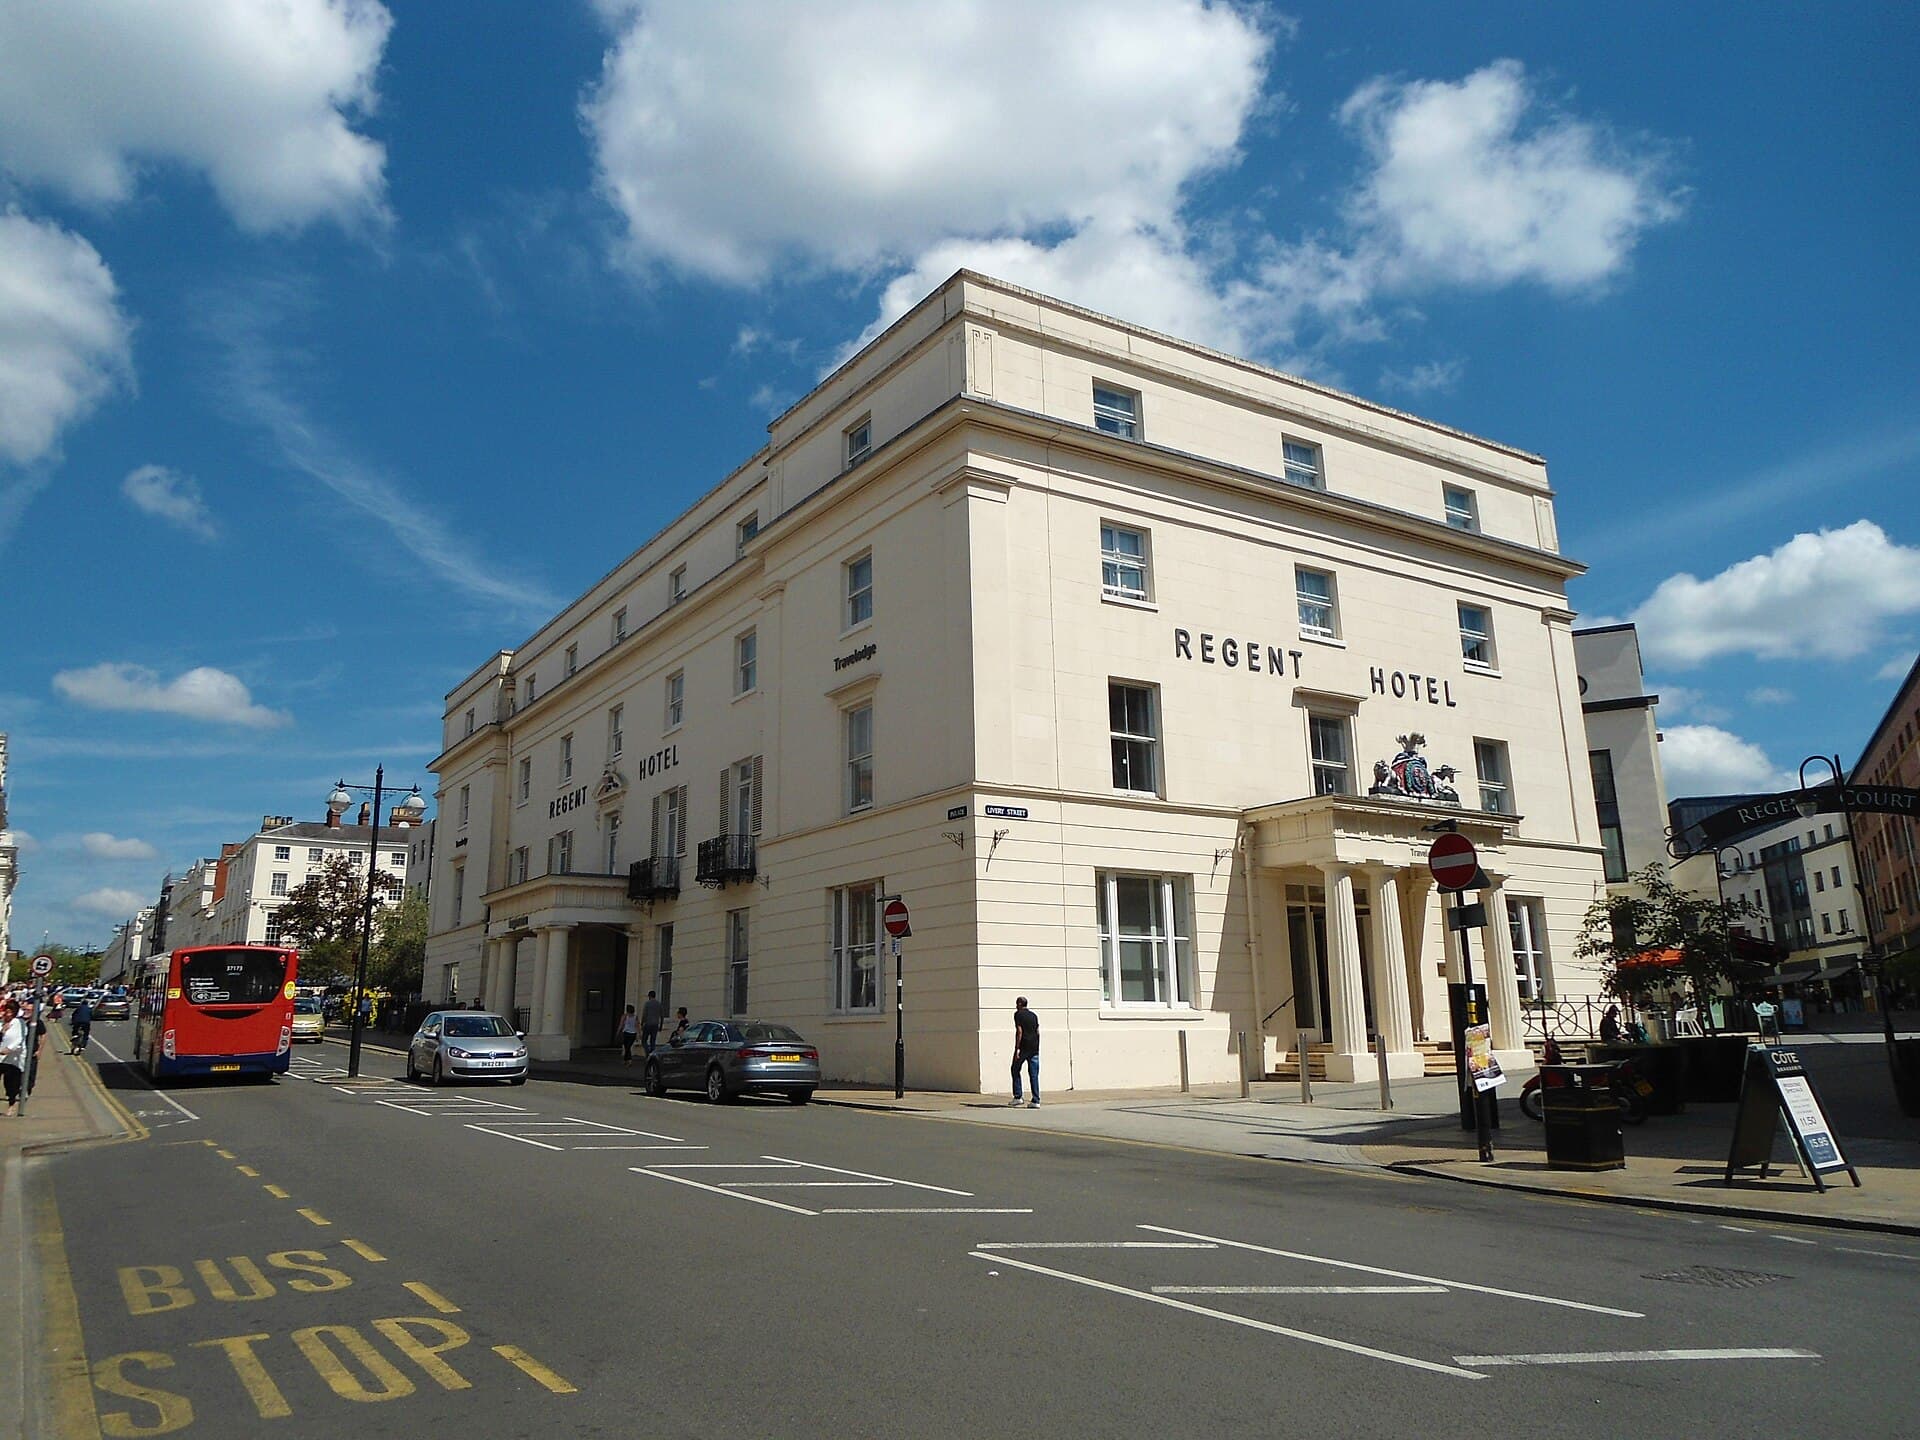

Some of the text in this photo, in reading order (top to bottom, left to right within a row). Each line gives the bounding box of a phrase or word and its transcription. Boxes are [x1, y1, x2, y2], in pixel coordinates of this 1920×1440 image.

[833, 643, 877, 672] Travelodge
[1174, 628, 1457, 707] REGENT HOTEL
[549, 745, 679, 819] REGENT HOTEL
[987, 807, 1026, 817] LIVERY STREET
[1737, 789, 1917, 824] REGE COURT
[1410, 848, 1429, 858] Travel
[1771, 1050, 1800, 1065] CÔTE
[116, 1250, 353, 1316] BUS
[93, 1316, 472, 1438] STOP
